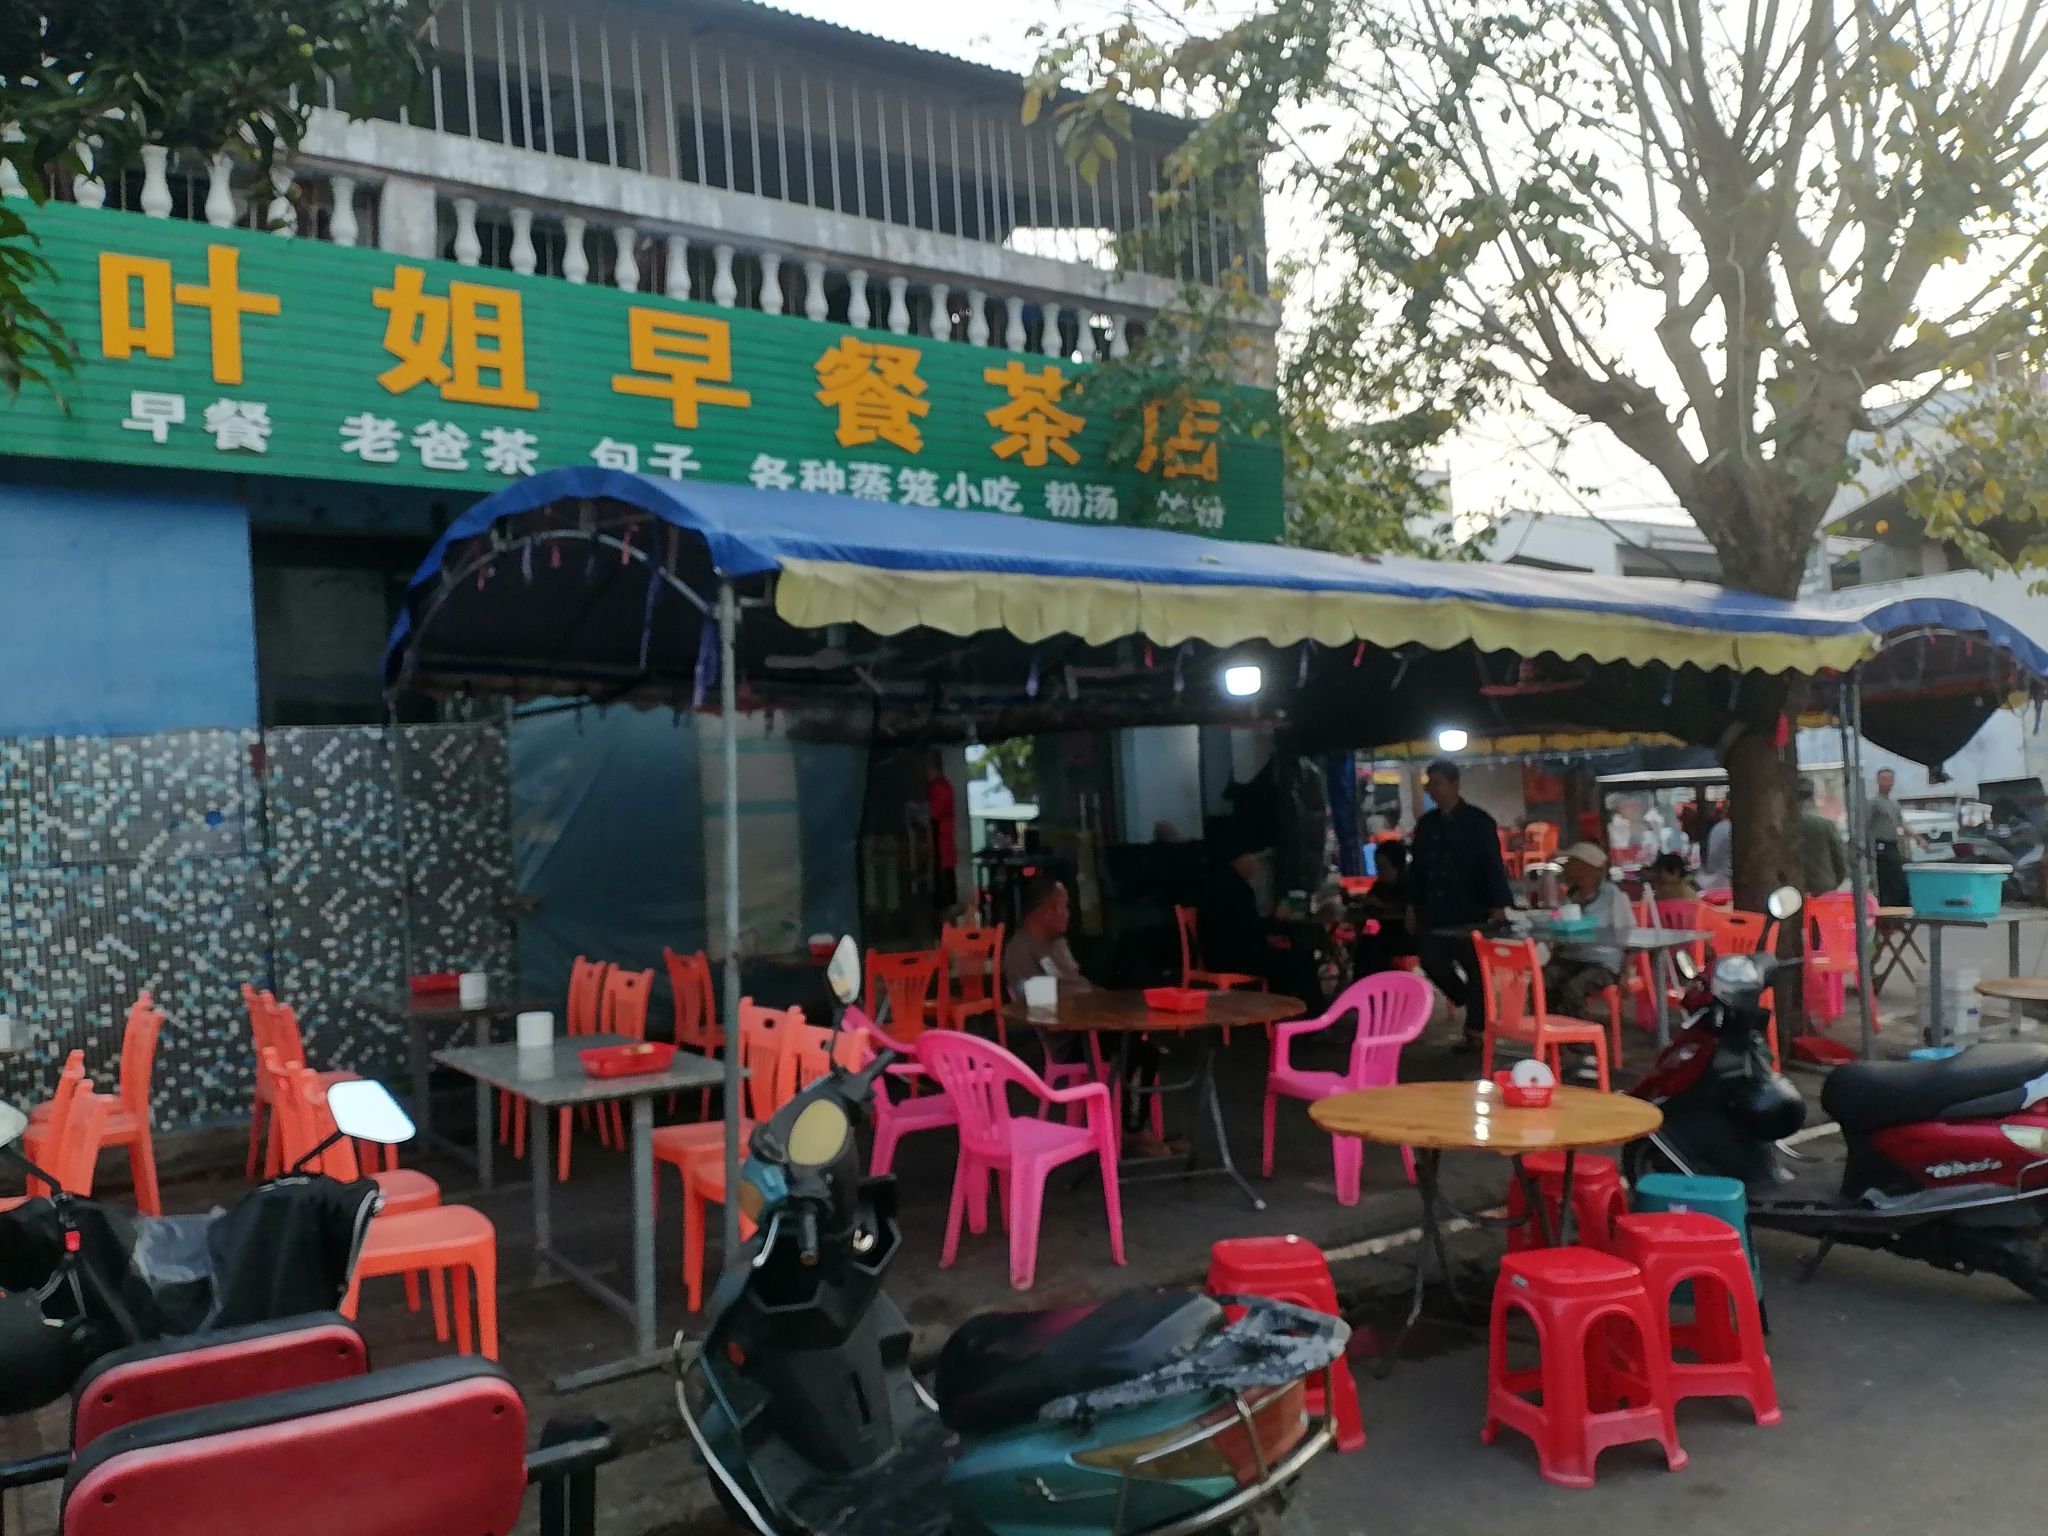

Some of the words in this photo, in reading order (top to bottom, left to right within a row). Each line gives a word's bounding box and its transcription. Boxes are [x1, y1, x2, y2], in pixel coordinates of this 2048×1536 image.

[99, 244, 1221, 482] 叶姐早餐茶店
[121, 390, 273, 453] 早餐
[338, 411, 540, 477] 老爸茶
[749, 452, 1024, 513] 各种蒸笼小吃
[1044, 479, 1119, 521] 粉汤
